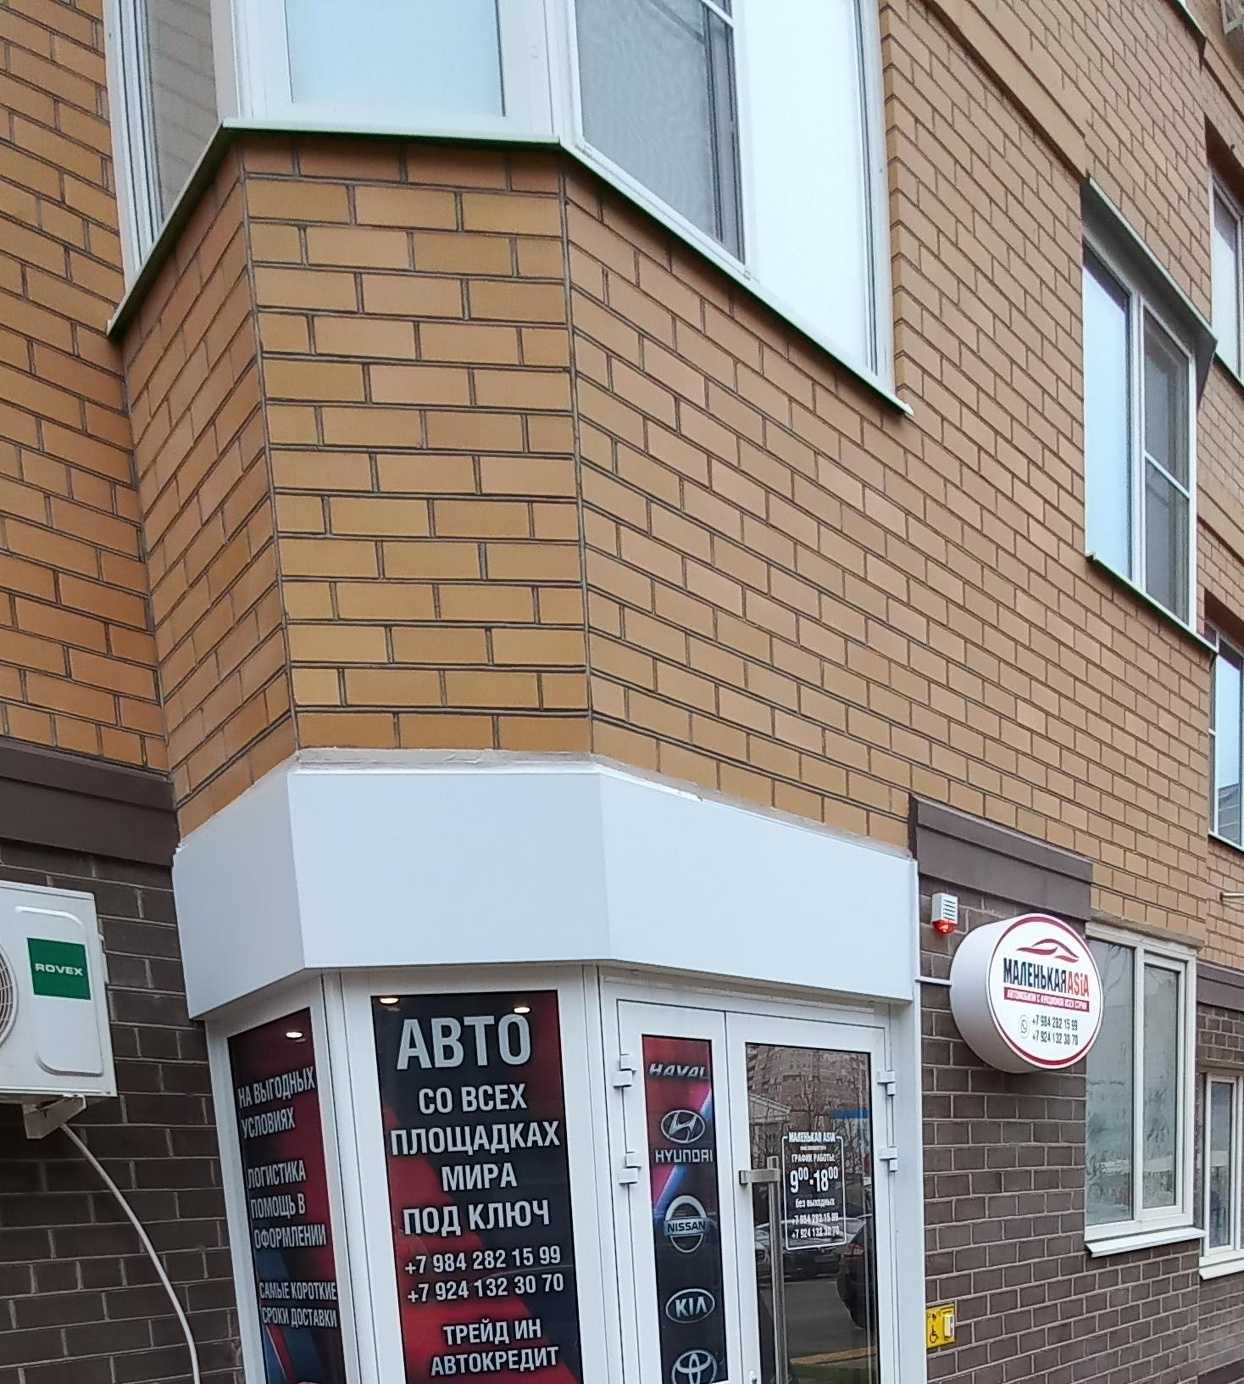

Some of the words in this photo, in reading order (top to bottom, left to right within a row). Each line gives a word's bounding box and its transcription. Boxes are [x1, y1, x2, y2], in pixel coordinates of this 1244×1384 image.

[35, 963, 84, 977] ROVEX
[1003, 957, 1067, 994] МАЛЕНЬКАЯ
[396, 1013, 532, 1071] АВТО
[649, 1063, 709, 1080] HAVAL
[237, 1084, 253, 1109] НА
[252, 1066, 317, 1103] ВЫГОДНЫХ
[418, 1087, 453, 1115] СО
[461, 1083, 528, 1113] ВСЕХ
[241, 1106, 296, 1140] УСЛОВИЯХ
[390, 1120, 561, 1156] ПЛОЩАДКАХ
[655, 1149, 714, 1163] HYUNDAI
[248, 1159, 307, 1190] ЛОГИСТИКА
[441, 1162, 518, 1192] МИРА
[250, 1195, 297, 1220] ПОМОЩЬ
[297, 1194, 306, 1216] В
[403, 1206, 462, 1237] ПОД
[468, 1199, 550, 1231] КЛЮЧ
[253, 1223, 327, 1250] ОФОРМЛЕНИИ
[667, 1220, 706, 1234] NISSAN
[405, 1255, 427, 1275] +7
[432, 1252, 467, 1273] 984
[472, 1249, 507, 1270] 282
[511, 1247, 534, 1267] 15
[539, 1245, 561, 1264] 99
[259, 1281, 291, 1301] САМЫЕ
[290, 1280, 338, 1302] КОРОТКИЕ
[407, 1283, 430, 1303] +7
[435, 1280, 469, 1301] 924
[474, 1277, 509, 1298] 132
[514, 1275, 537, 1294] 30
[541, 1273, 565, 1293] 70
[261, 1306, 290, 1326] СРОКИ
[290, 1307, 338, 1328] ДОСТАВКИ
[675, 1296, 708, 1318] KIA
[443, 1318, 510, 1346] ТРЕЙД
[515, 1318, 542, 1339] ИН
[431, 1346, 559, 1377] АВТОКРЕДИТ
